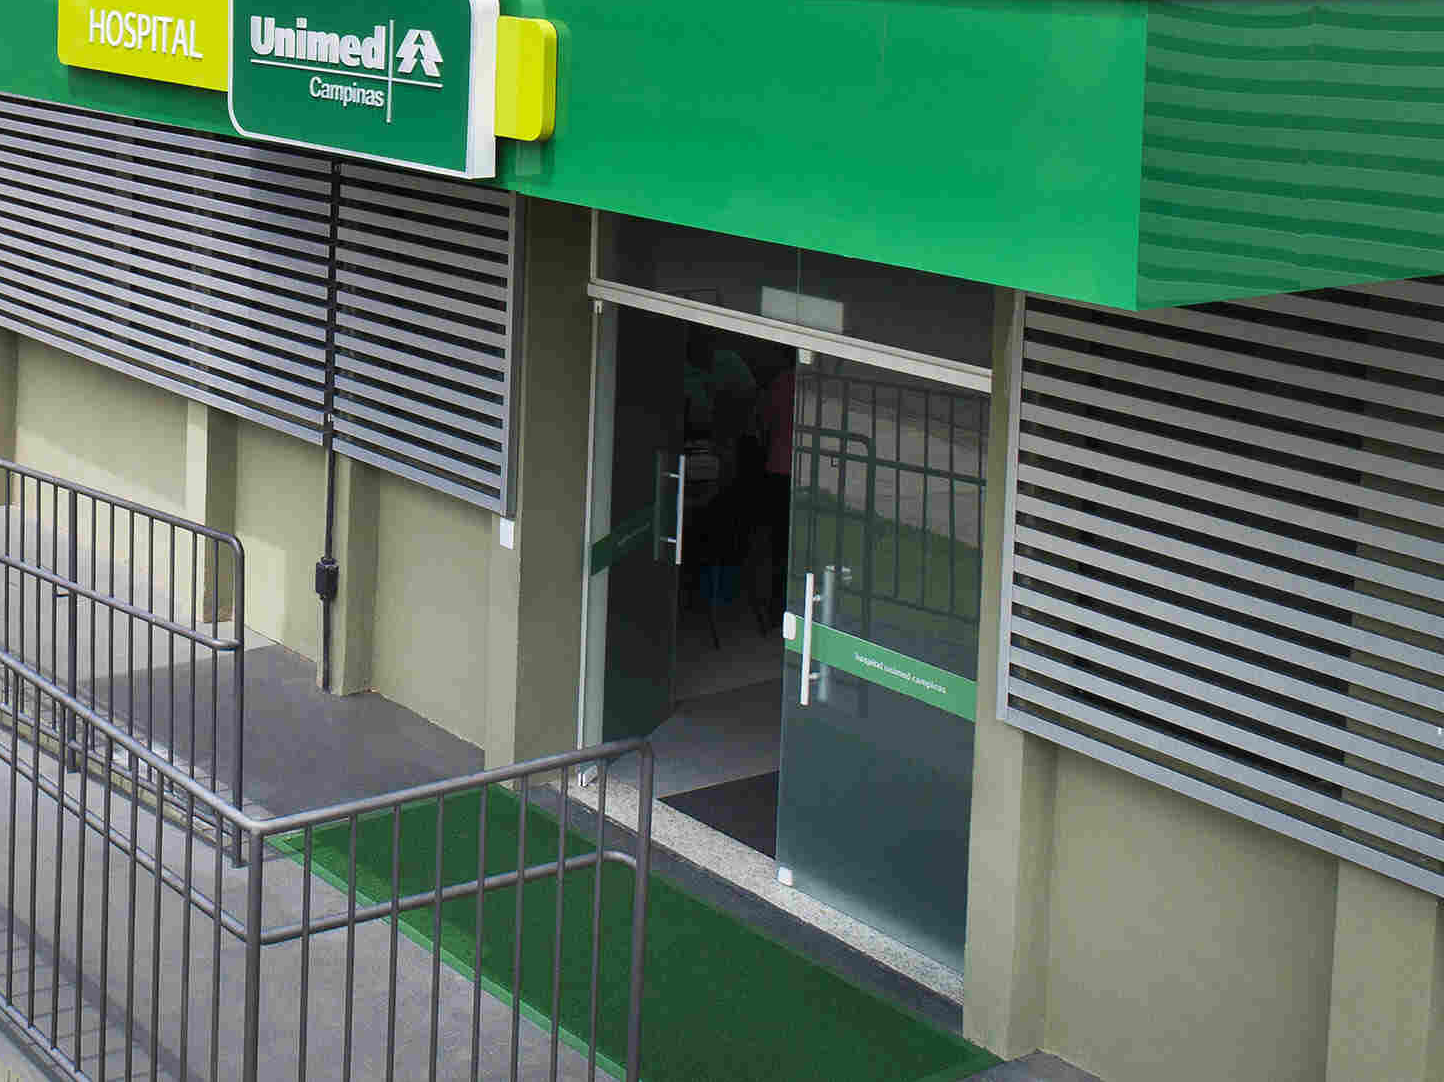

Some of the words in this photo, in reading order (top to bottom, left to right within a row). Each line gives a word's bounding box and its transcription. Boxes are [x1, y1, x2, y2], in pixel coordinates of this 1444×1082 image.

[88, 7, 204, 60] HOSPITAL
[250, 15, 386, 71] Unimed
[309, 76, 385, 109] Campinas
